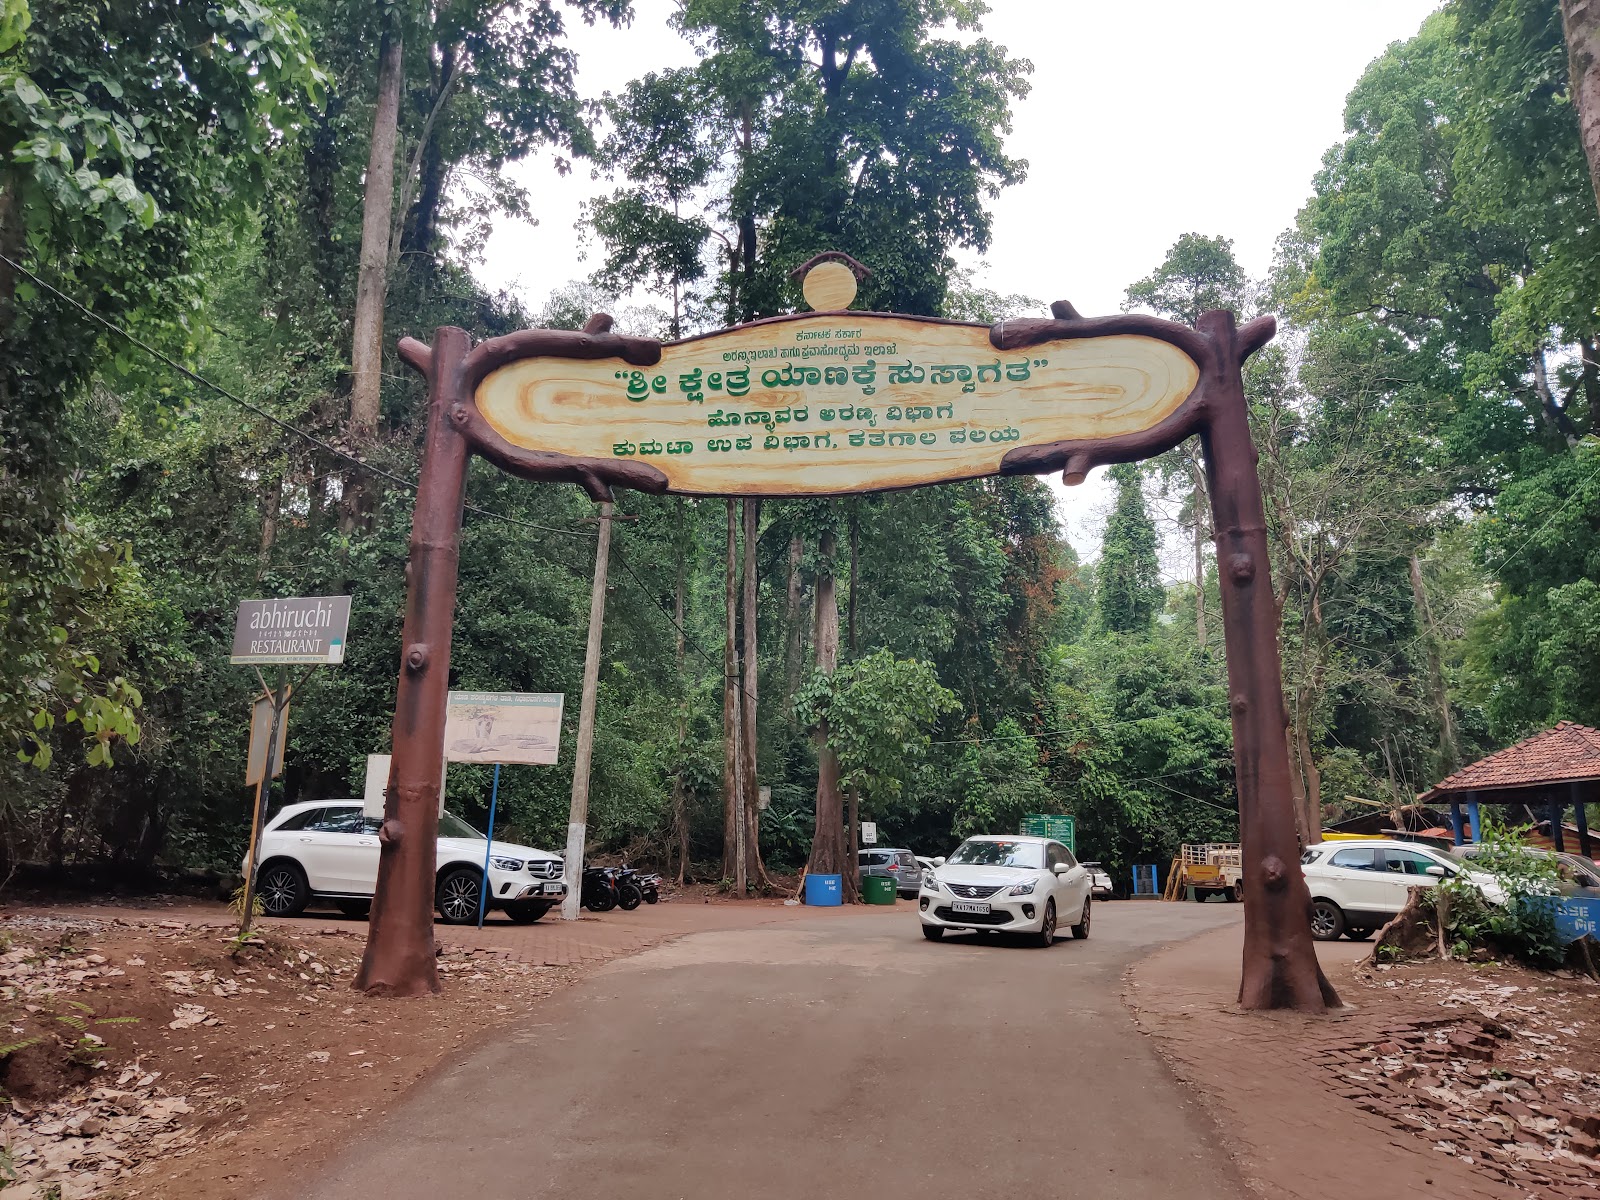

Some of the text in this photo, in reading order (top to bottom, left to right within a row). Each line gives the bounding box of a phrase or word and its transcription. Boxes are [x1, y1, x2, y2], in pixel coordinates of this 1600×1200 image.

[796, 329, 862, 341] ಕರ್ನಾಟಕ ಸರ್ಕಾರ
[678, 364, 751, 404] ಕ್ಷೇತ್ರ
[761, 359, 877, 395] ಯಾಣಕ್ಕೆ
[707, 402, 954, 433] ಹೊನ್ನಾವರ ಅರಣ್ಯ ವಿಭಾಗ
[612, 438, 694, 456] ಕುಮಟಾ
[707, 433, 753, 452] ಉಪ
[848, 429, 937, 447] ಕತಗಾಲ
[949, 426, 1020, 443] ವಲಯ
[250, 601, 333, 629] abhiruchi
[250, 639, 322, 654] RESTAURANT
[1574, 918, 1597, 932] ME
